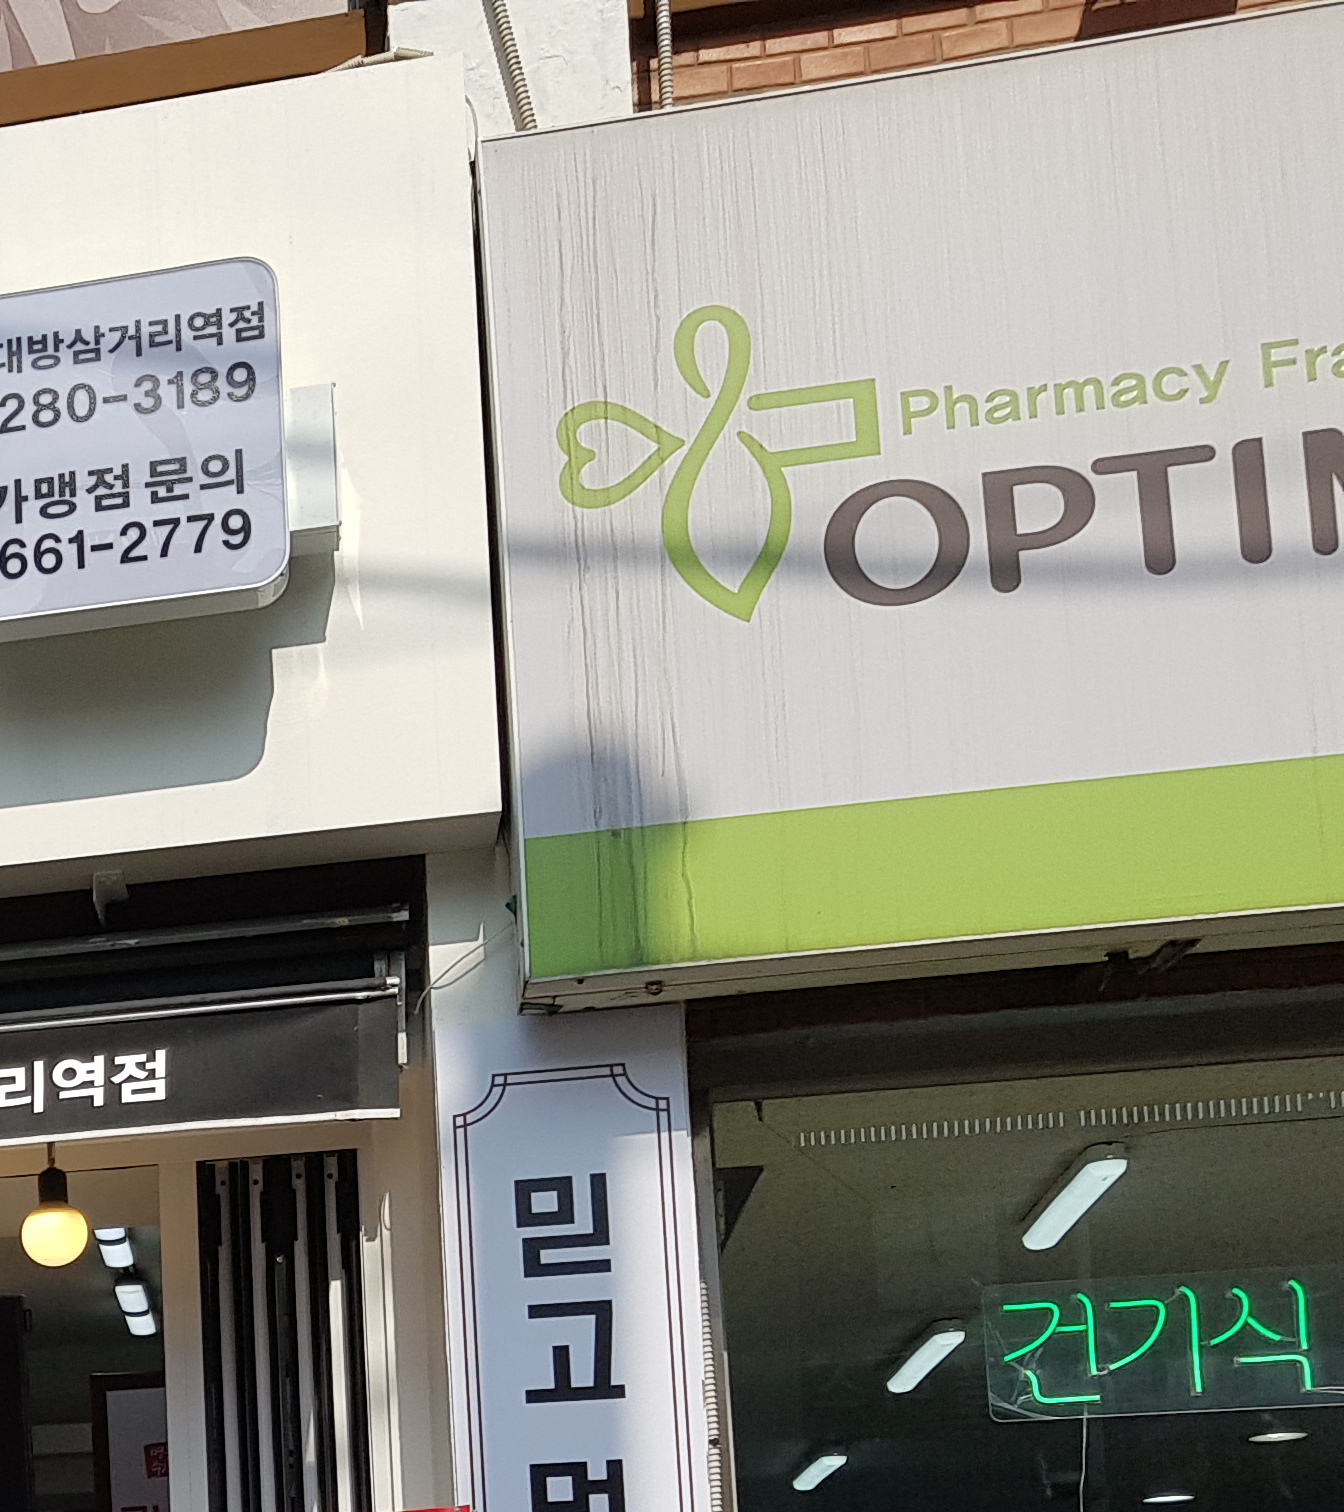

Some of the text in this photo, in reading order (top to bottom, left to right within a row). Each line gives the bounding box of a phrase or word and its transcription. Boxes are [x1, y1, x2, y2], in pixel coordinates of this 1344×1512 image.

[900, 358, 1230, 436] Pharmacy
[514, 1171, 627, 1404] 믿고
[1002, 1279, 1313, 1405] 건기식
